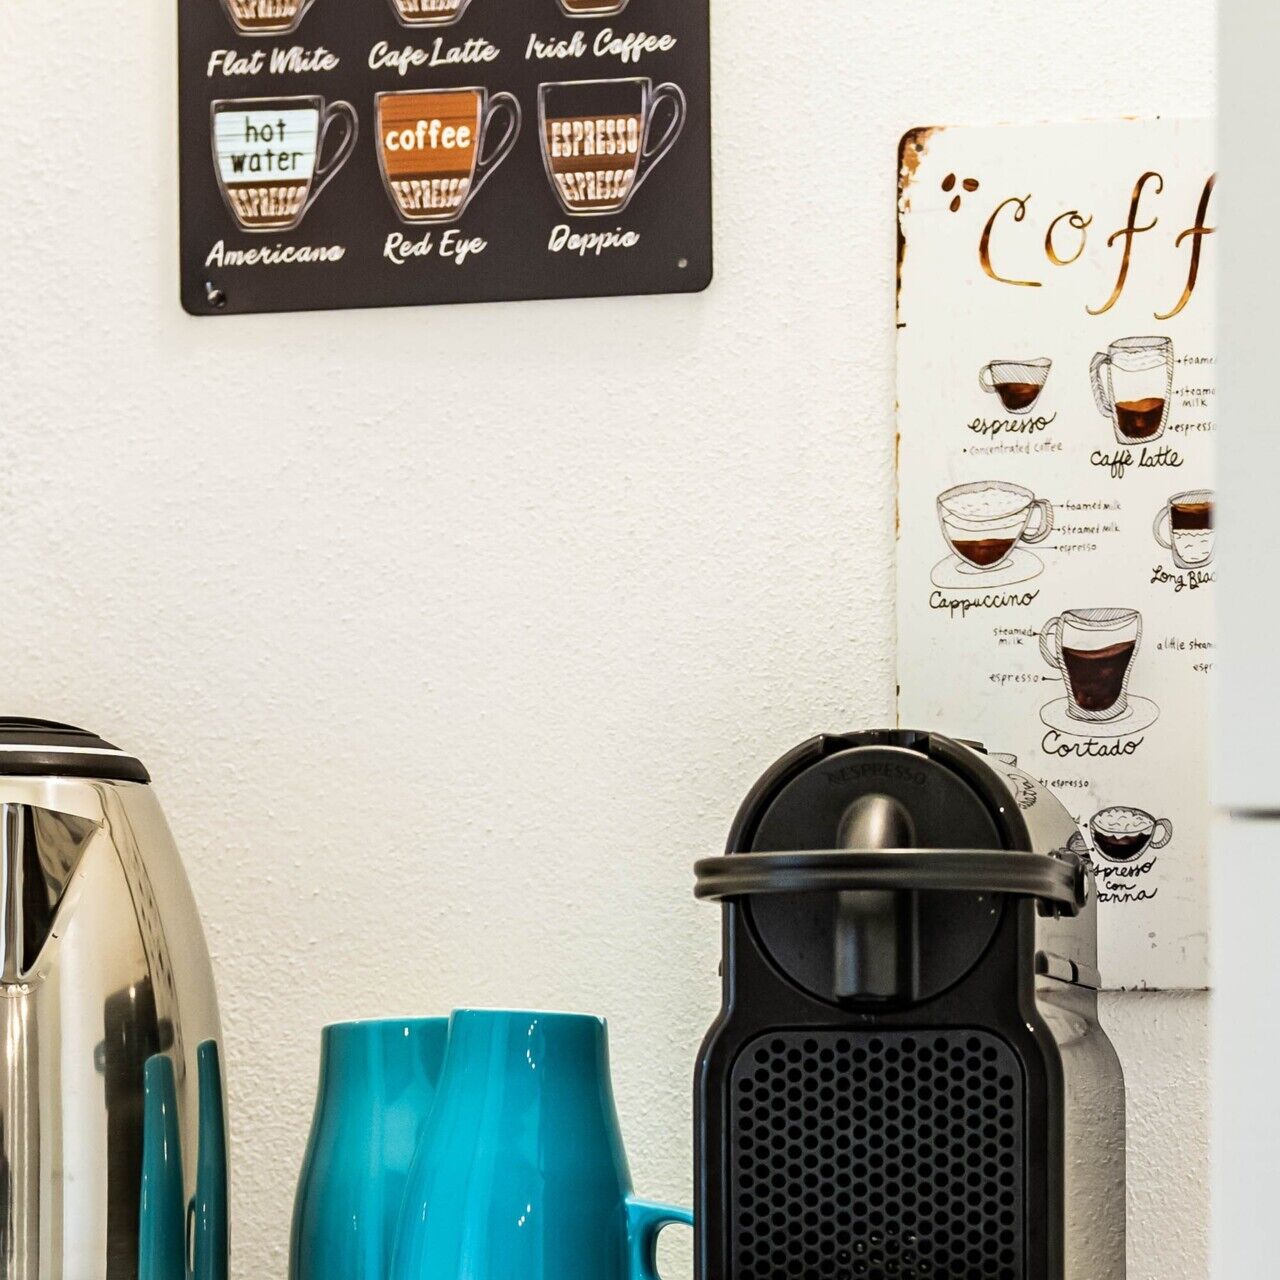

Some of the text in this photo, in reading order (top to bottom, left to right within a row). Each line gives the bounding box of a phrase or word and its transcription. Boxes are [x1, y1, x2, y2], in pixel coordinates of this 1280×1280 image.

[368, 37, 500, 76] Cafe Latte
[525, 27, 677, 64] Irish Coffee
[207, 46, 340, 77] Flat White
[244, 115, 287, 143] hot
[385, 118, 472, 151] coffee
[551, 117, 638, 158] ESPRESSO
[230, 149, 304, 173] water
[390, 177, 470, 210] ESPRESSO
[554, 168, 635, 201] ESPRESSO
[205, 239, 346, 268] Americano
[383, 229, 488, 266] Red Eye
[547, 224, 641, 257] Doppio
[978, 171, 1217, 320] Coff
[1183, 354, 1217, 366] foame
[967, 411, 1057, 440] espresso
[1138, 445, 1184, 467] latte
[1059, 543, 1097, 556] espresso
[1150, 565, 1187, 592] Long
[929, 589, 1040, 619] Cappuccino
[993, 625, 1033, 637] steamed
[989, 673, 1039, 686] espresso
[1041, 730, 1144, 757] Cortado
[1051, 779, 1089, 788] espresso
[1093, 857, 1157, 881] spresso
[1106, 881, 1136, 890] con
